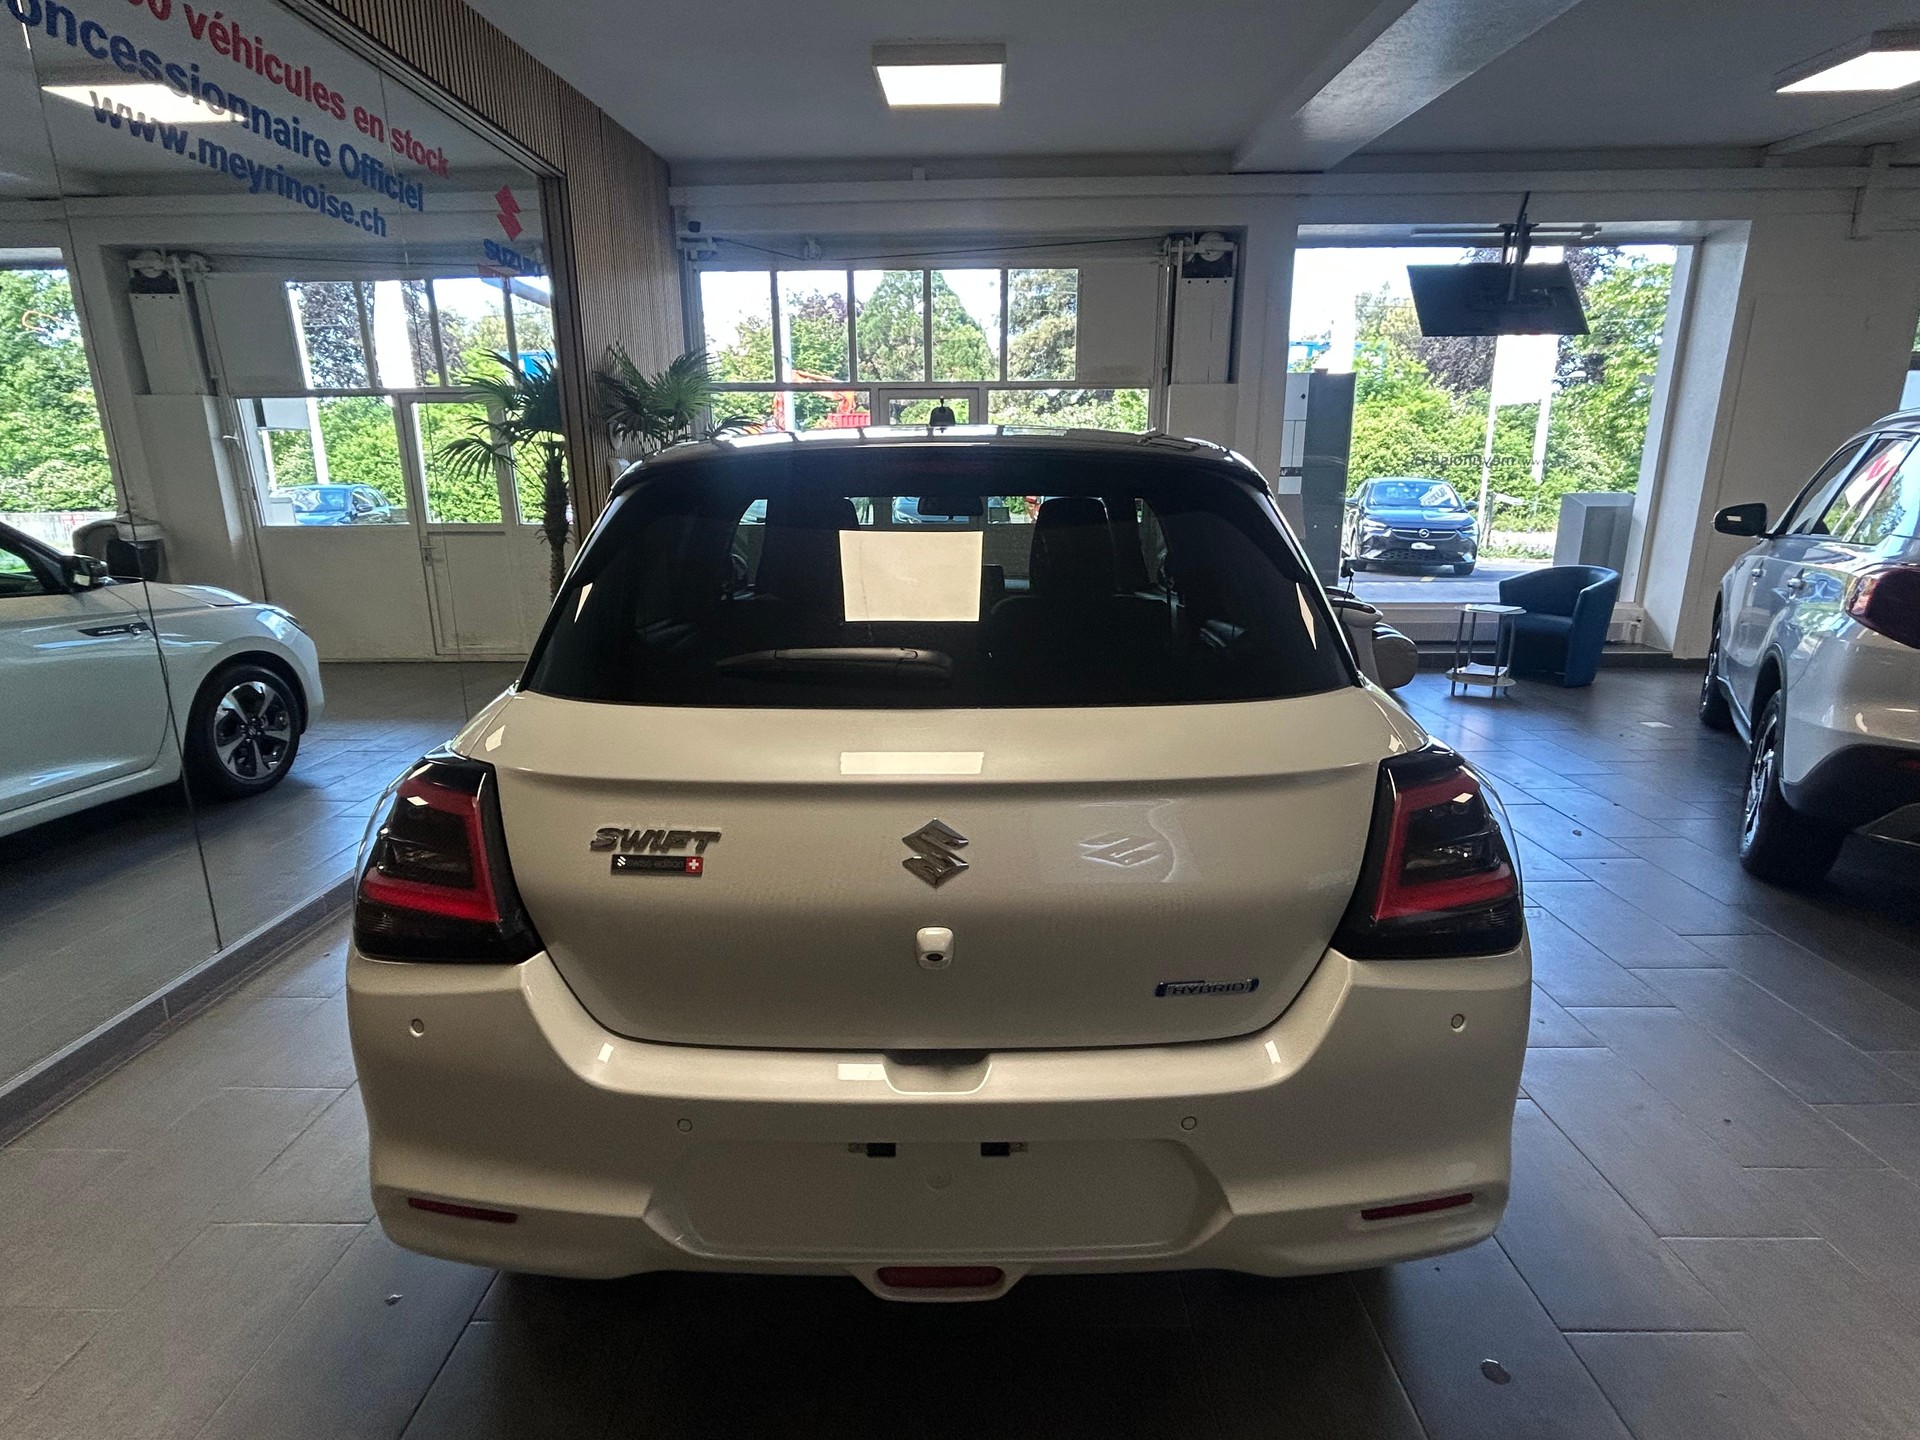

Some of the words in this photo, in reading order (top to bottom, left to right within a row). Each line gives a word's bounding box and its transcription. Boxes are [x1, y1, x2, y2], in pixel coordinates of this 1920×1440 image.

[183, 3, 347, 121] véhicules
[353, 106, 385, 144] en
[391, 126, 450, 181] stock
[89, 90, 387, 238] www.meyrinoise.ch
[338, 142, 425, 213] Officiel
[590, 827, 722, 855] SWIFT
[1172, 982, 1246, 995] HYBRID
